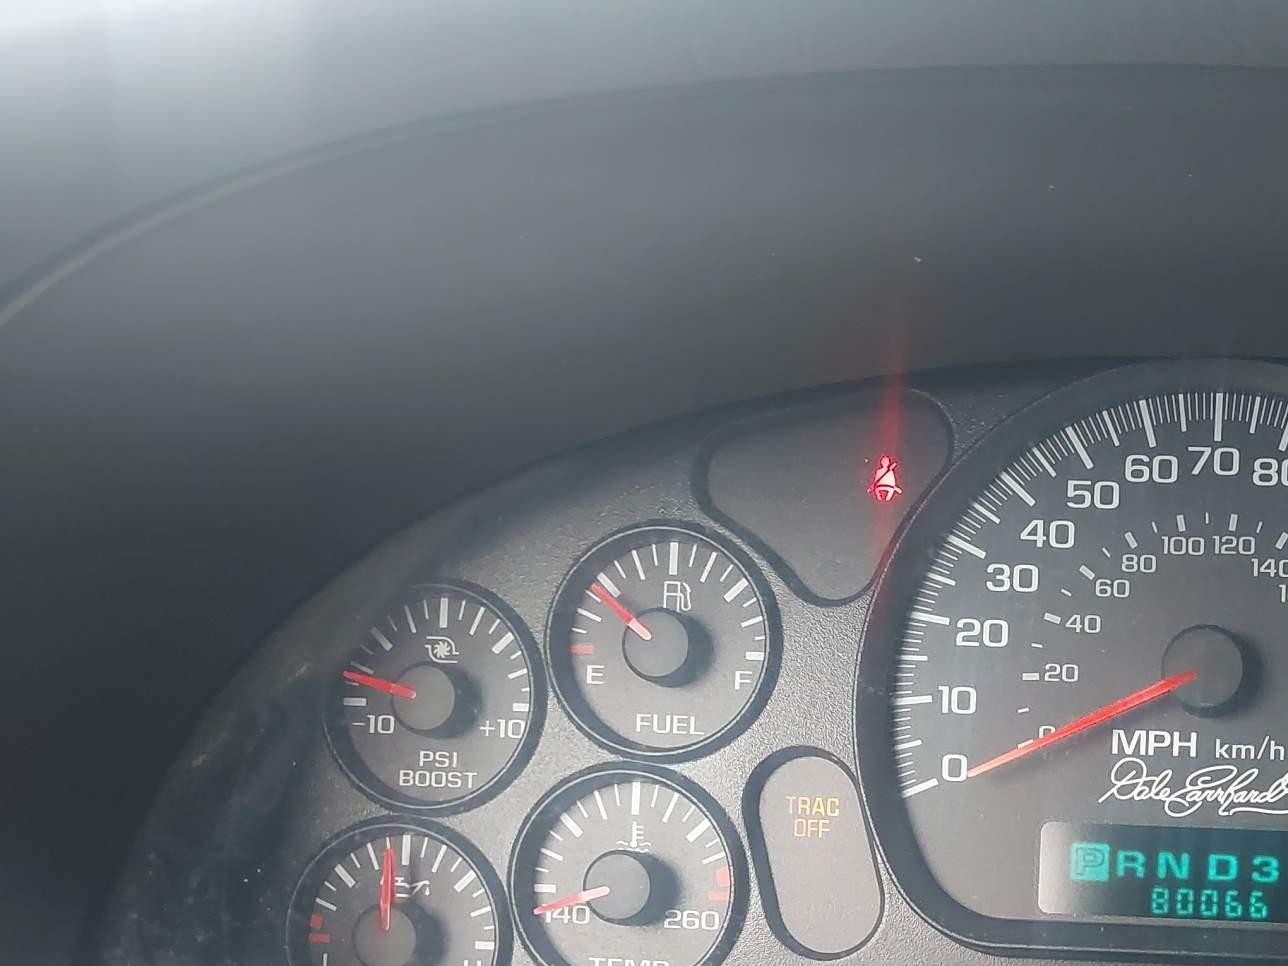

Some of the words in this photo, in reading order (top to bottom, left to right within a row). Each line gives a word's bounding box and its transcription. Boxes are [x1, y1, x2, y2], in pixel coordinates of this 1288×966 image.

[1124, 454, 1178, 483] 60
[1187, 447, 1240, 476] 70
[1066, 480, 1120, 509] 50
[1020, 519, 1075, 548] 40
[1161, 536, 1204, 556] 100
[1212, 535, 1256, 555] 120
[1121, 555, 1156, 573] 80
[986, 563, 1039, 592] 30
[1095, 580, 1130, 598] 60
[955, 619, 1009, 648] 20
[1065, 615, 1101, 634] 40
[586, 665, 605, 685] E
[735, 670, 753, 690] F
[1044, 663, 1079, 682] 20
[938, 686, 977, 714] 10
[352, 715, 395, 734] -10
[479, 719, 525, 738] +10
[635, 713, 705, 736] FUEL
[1111, 729, 1198, 758] MPH
[1214, 735, 1286, 761] km/h
[419, 751, 458, 768] PSI
[942, 754, 968, 781] 0
[400, 770, 478, 789] BOOST
[1098, 758, 1172, 803] Dale
[785, 795, 839, 816] TRAC
[794, 818, 830, 838] OFF
[1151, 887, 1268, 919] 80066
[544, 903, 590, 924] 140
[664, 910, 719, 930] 260
